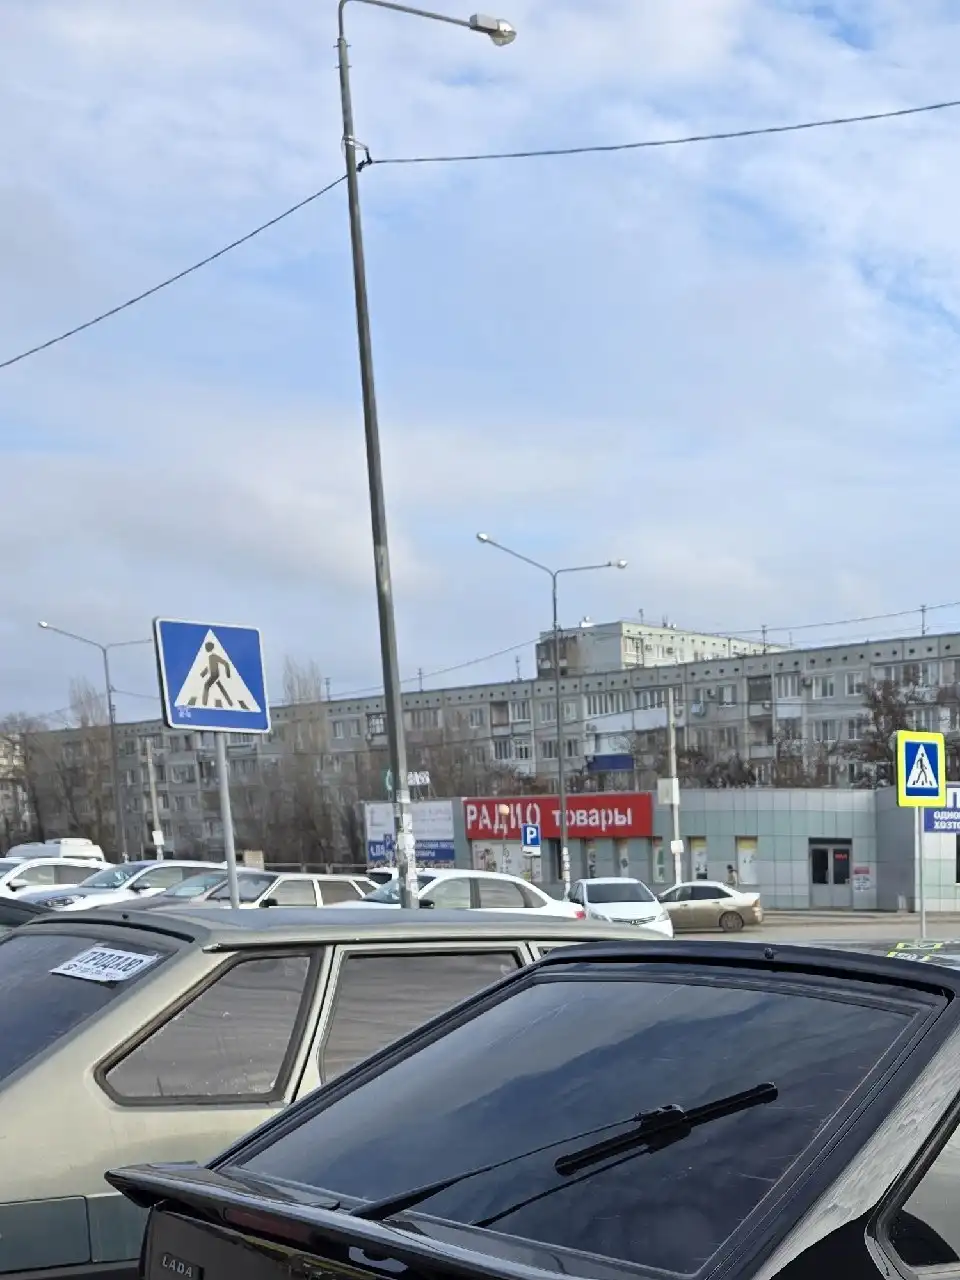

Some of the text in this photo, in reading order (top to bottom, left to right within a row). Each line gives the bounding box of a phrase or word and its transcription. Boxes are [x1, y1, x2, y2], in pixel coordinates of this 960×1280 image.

[466, 802, 633, 834] РАДИО товары
[162, 1255, 192, 1277] LADA
